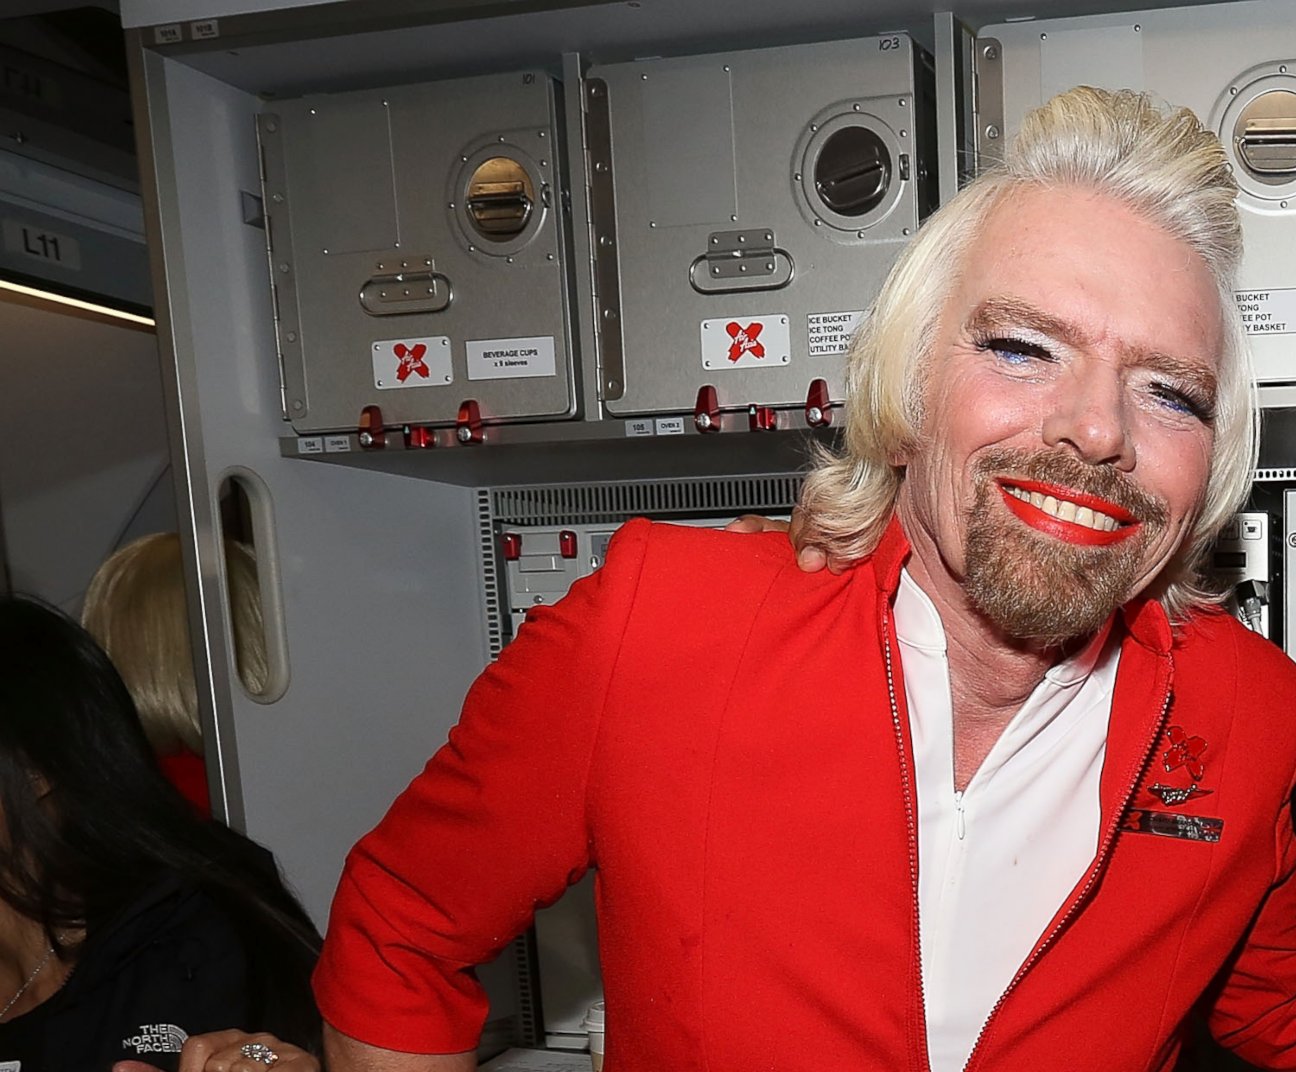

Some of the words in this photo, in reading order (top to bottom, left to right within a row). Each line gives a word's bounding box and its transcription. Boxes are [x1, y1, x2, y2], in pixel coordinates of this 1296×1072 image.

[879, 37, 900, 51] 103
[22, 228, 61, 262] L11
[1236, 293, 1270, 302] BUCKET
[809, 316, 821, 324] ICE
[822, 315, 852, 323] BUCKET
[1255, 313, 1272, 321] POT
[809, 326, 821, 334] ICE
[823, 325, 844, 333] TONG
[1253, 323, 1286, 332] BASKET
[809, 335, 838, 343] COFFEE
[810, 345, 837, 353] UTILITY
[483, 350, 518, 358] BEVERAGE
[139, 1023, 168, 1034] THE
[122, 1034, 168, 1049] NORTH
[136, 1042, 171, 1054] FACE
